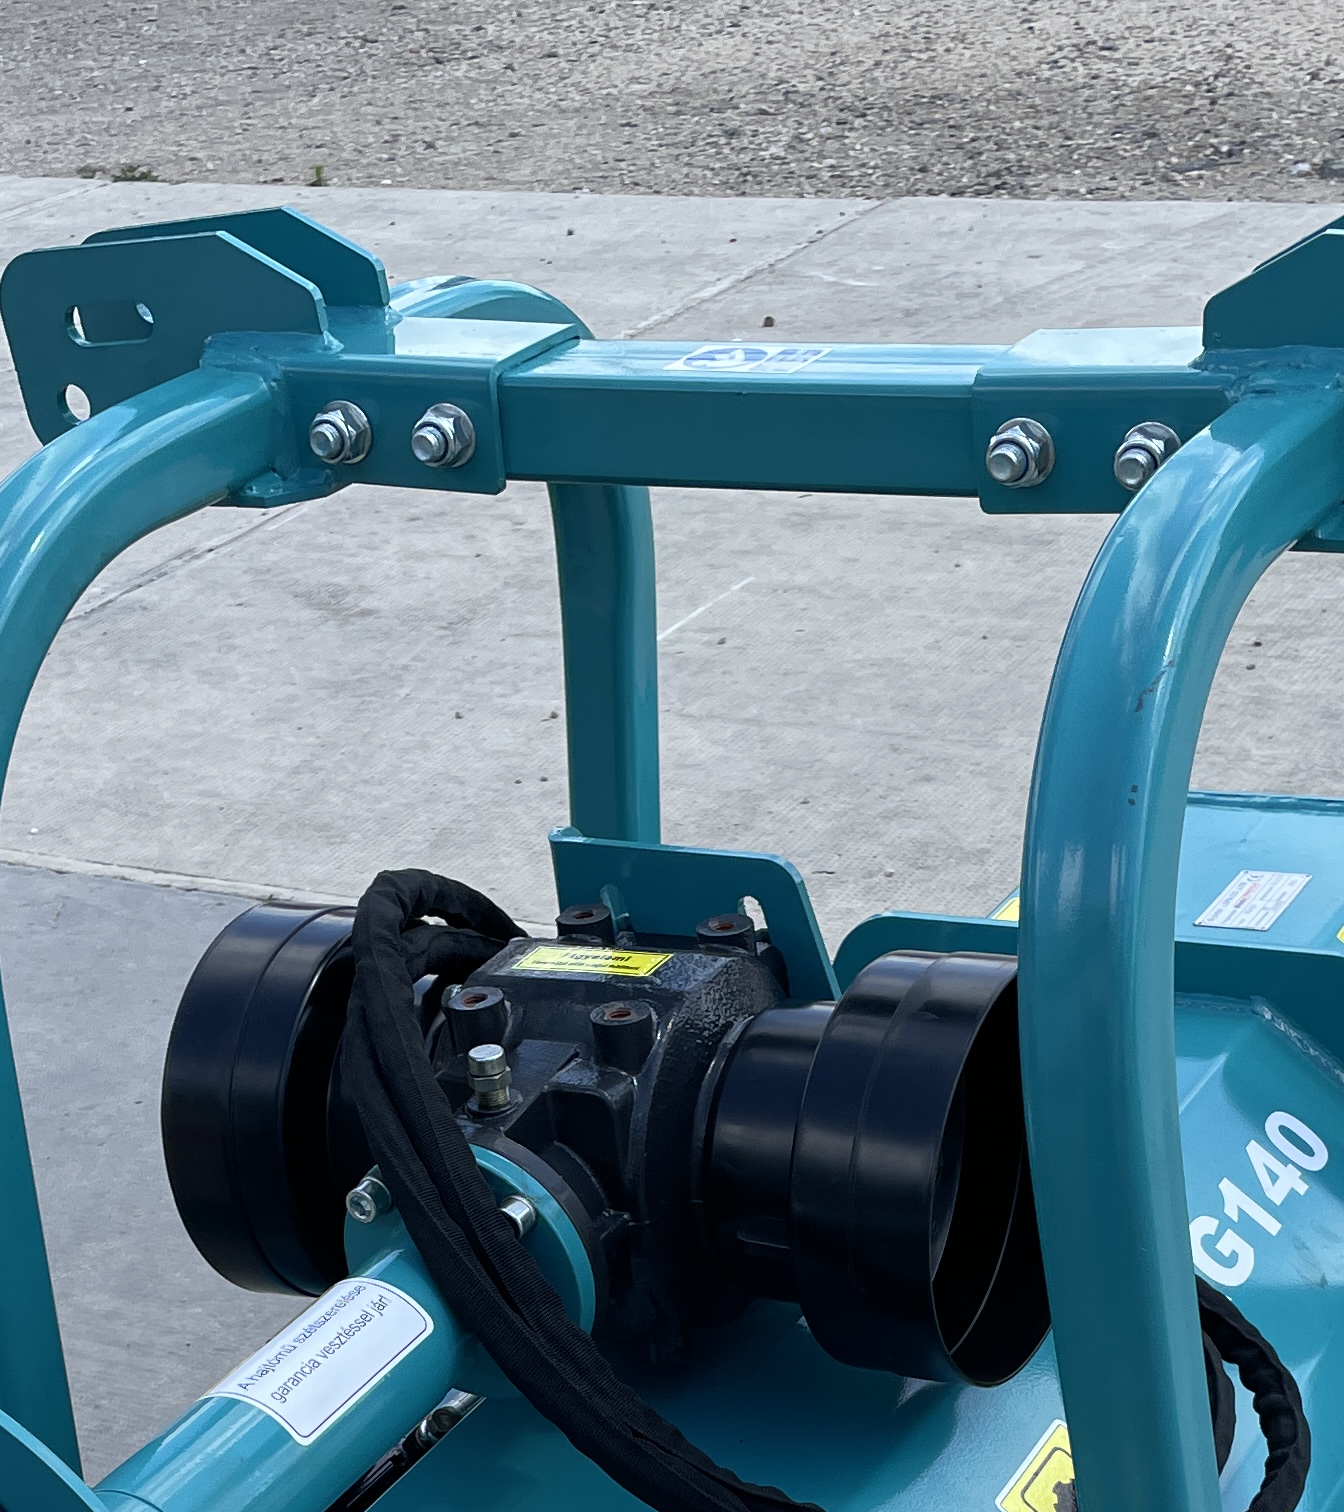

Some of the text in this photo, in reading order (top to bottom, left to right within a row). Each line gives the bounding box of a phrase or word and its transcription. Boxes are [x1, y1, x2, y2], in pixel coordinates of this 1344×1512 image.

[270, 1357, 322, 1404] garancia
[315, 1308, 376, 1360] vesztéssel
[237, 1382, 254, 1391] A
